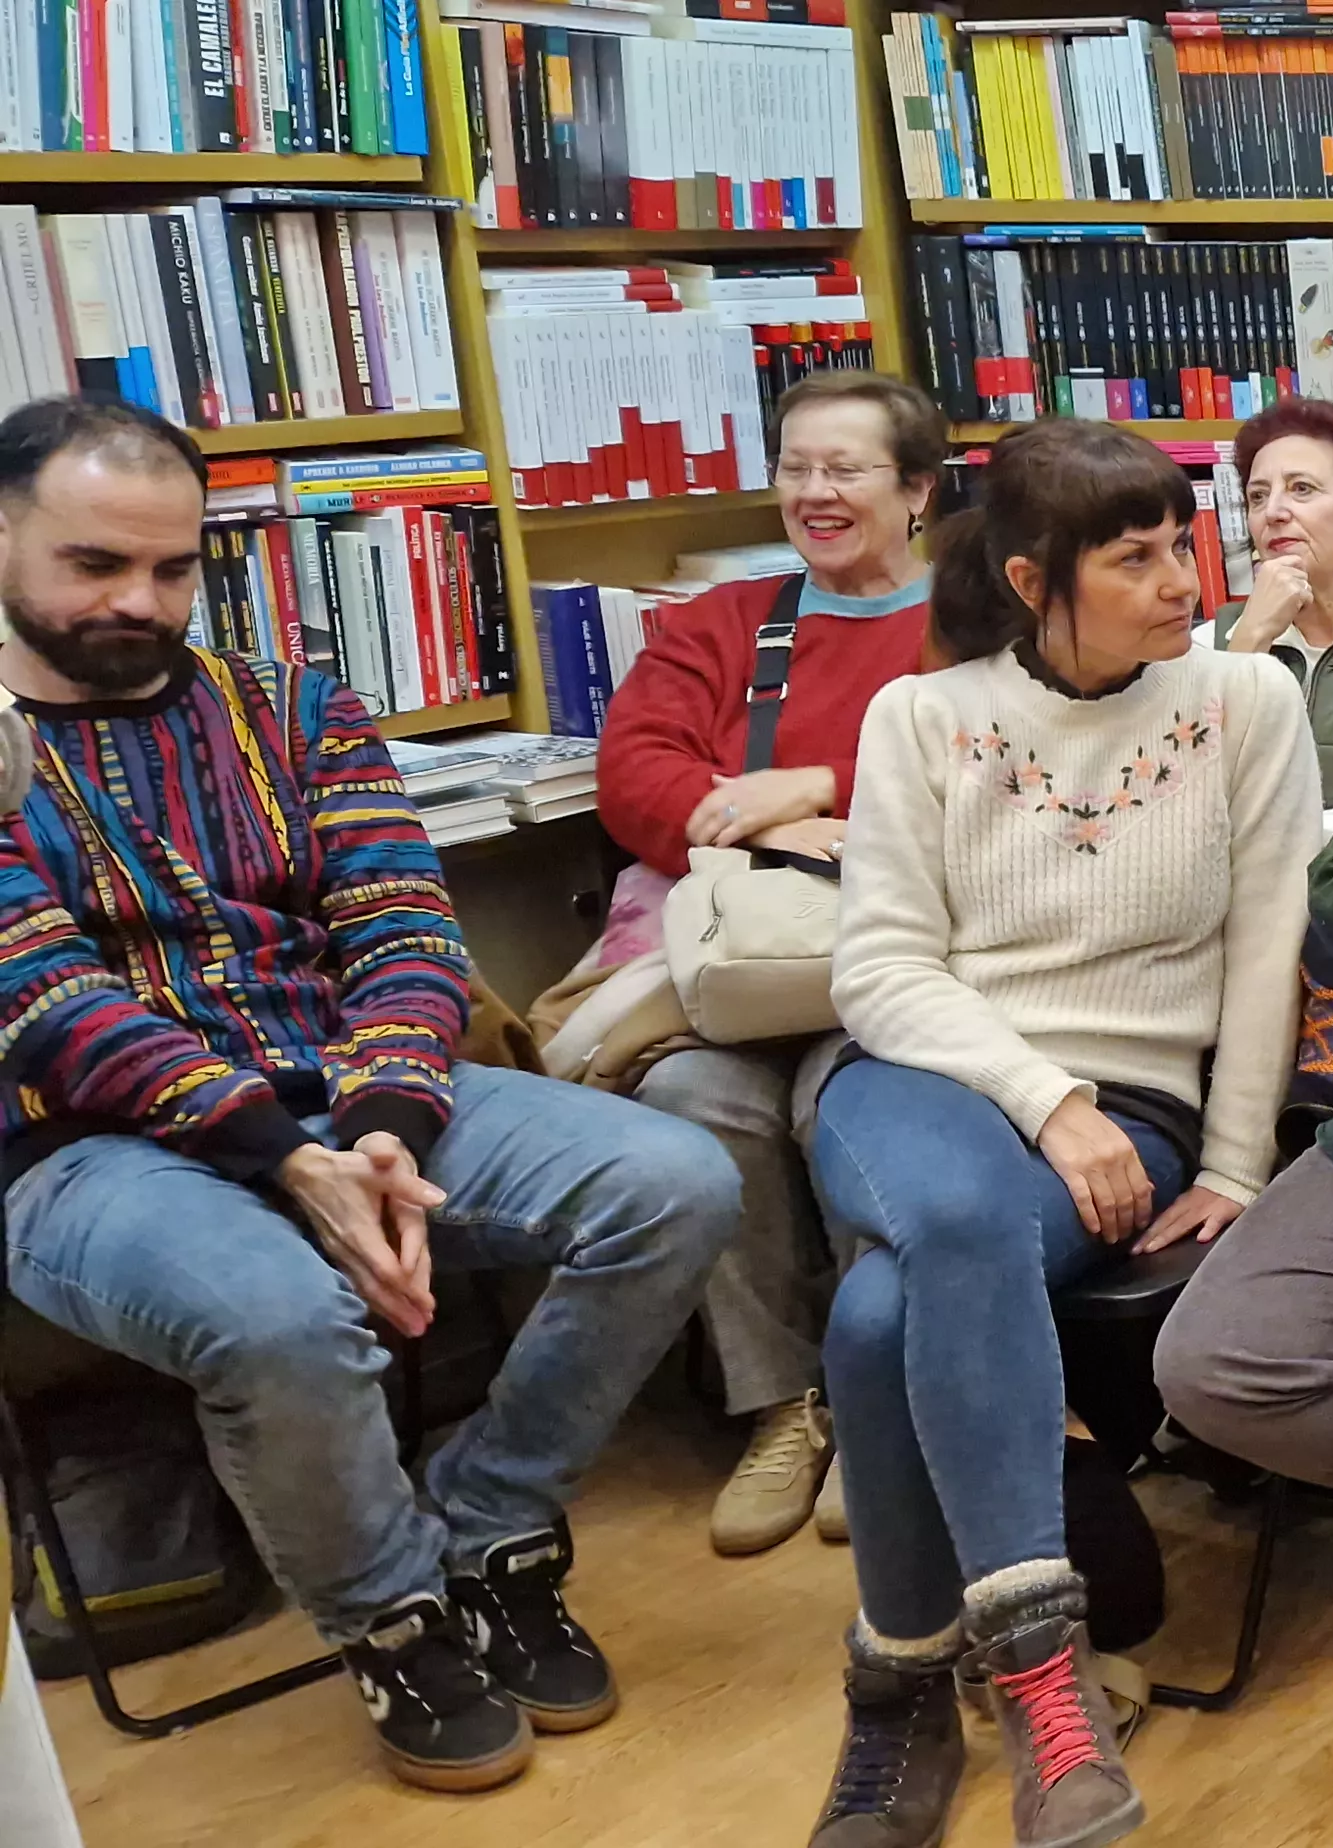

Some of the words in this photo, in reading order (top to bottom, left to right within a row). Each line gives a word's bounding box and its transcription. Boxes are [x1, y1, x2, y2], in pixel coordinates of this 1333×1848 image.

[196, 0, 223, 73] CAMALE
[203, 78, 225, 98] EL
[169, 221, 187, 268] MICHIO
[177, 272, 194, 305] KAKU
[304, 532, 321, 586] MEMORIA
